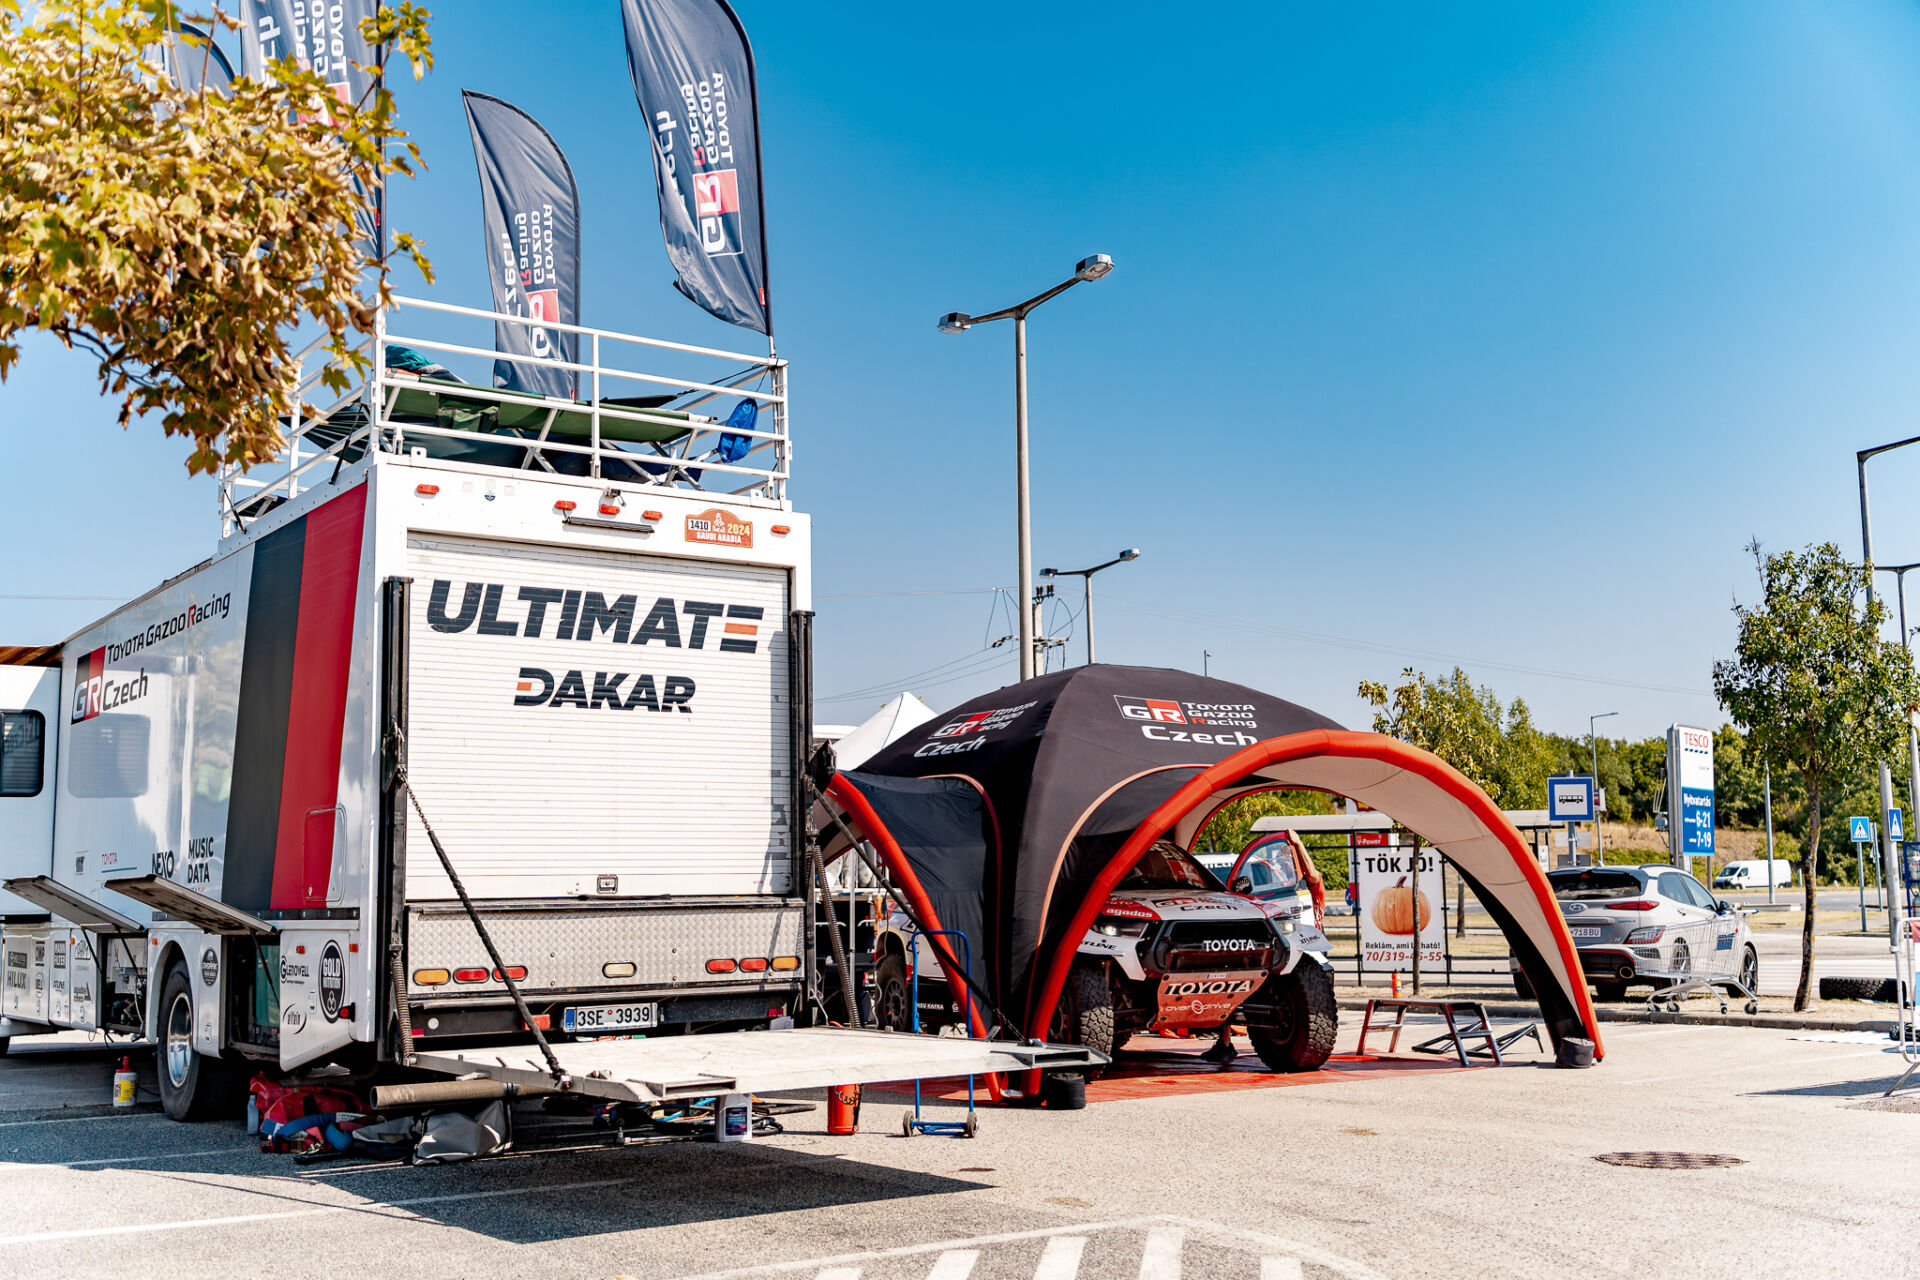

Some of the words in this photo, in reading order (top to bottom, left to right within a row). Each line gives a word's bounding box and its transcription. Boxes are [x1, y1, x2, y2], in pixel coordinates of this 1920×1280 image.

[690, 520, 708, 530] 1410
[727, 523, 750, 536] 2024
[426, 579, 764, 654] ULTIMATE
[108, 633, 144, 664] TOYOTA
[146, 613, 186, 646] GAZOO
[187, 592, 230, 628] Racing
[73, 676, 102, 720] GR
[102, 668, 148, 711] Czech
[514, 667, 696, 713] DAKAR
[1122, 705, 1185, 723] GR
[1182, 702, 1256, 711] TOYOTA
[1188, 710, 1253, 718] GAZOO
[934, 721, 980, 736] GR
[1191, 717, 1257, 728] Racing
[1141, 725, 1258, 746] Czech
[1684, 733, 1709, 748] TESCO
[914, 735, 986, 757] Czech
[188, 836, 214, 859] MUSIC
[1365, 853, 1401, 872] TÖK
[188, 863, 210, 884] DATA
[1106, 908, 1152, 918] agados
[1203, 939, 1256, 952] TOYOTA
[323, 958, 341, 977] GOLD
[1168, 980, 1251, 995] TOYOTA
[578, 1010, 604, 1026] 3SE
[616, 1007, 650, 1023] 3939
